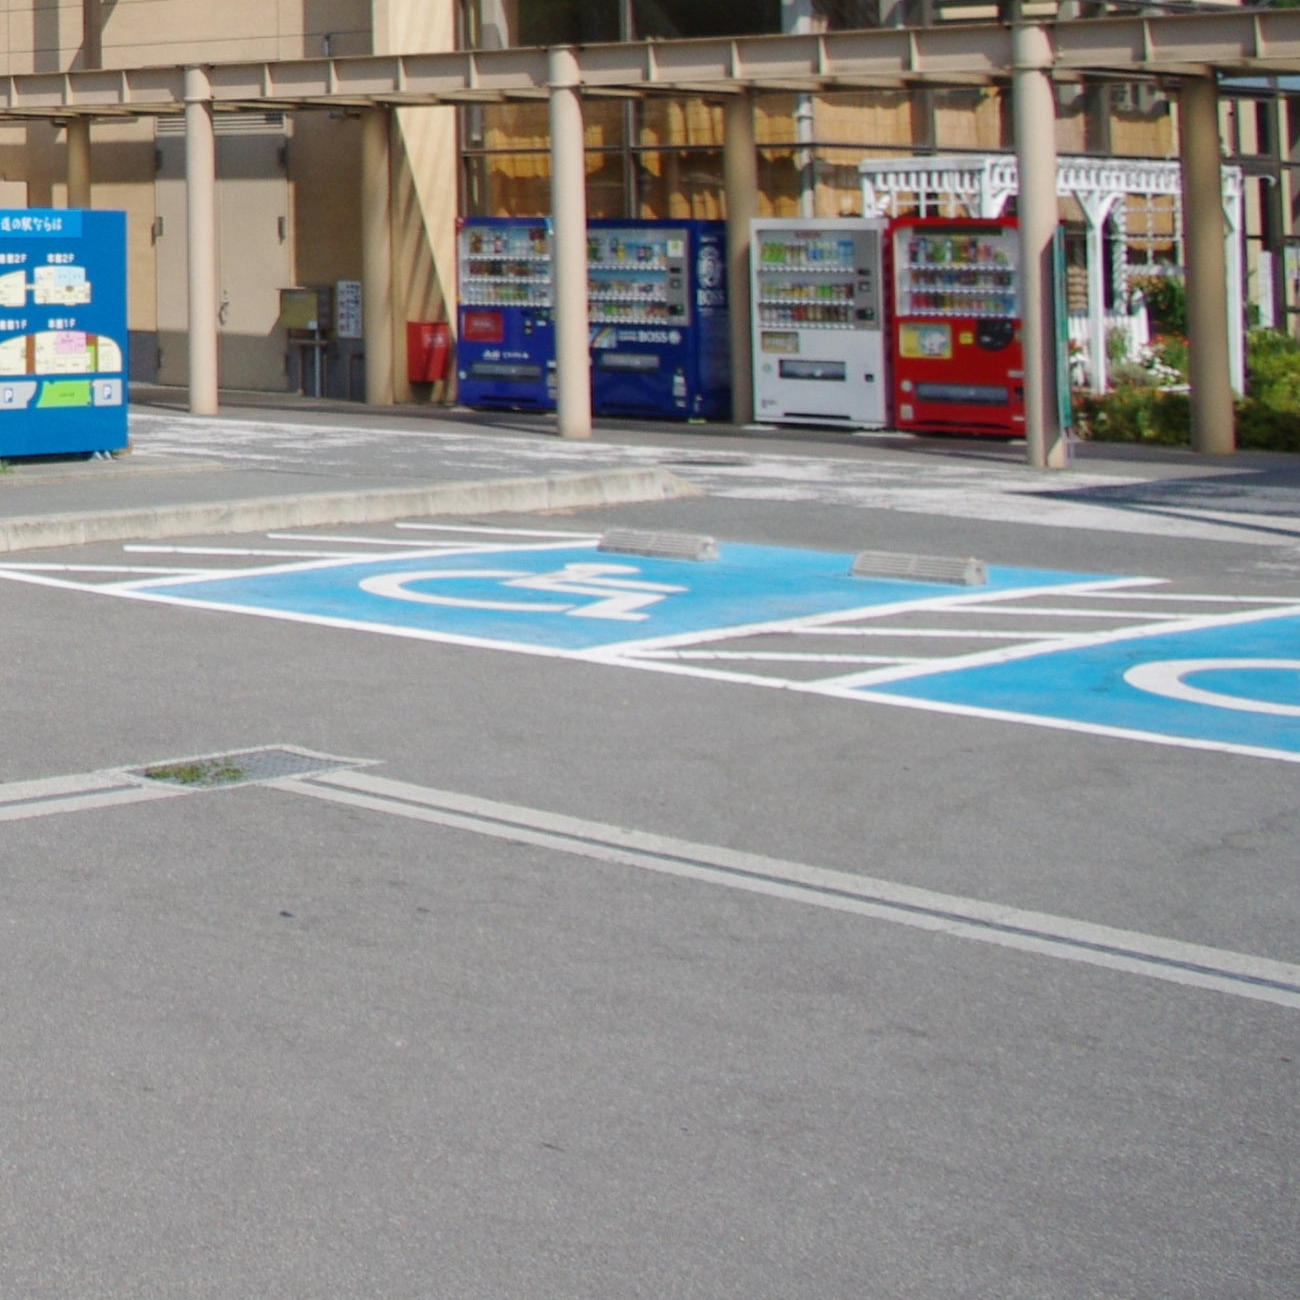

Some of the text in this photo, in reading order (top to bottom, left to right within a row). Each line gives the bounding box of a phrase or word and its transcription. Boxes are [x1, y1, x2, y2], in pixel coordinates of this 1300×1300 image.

[0, 216, 63, 232] 道の駅ならは
[638, 330, 669, 344] BOSS
